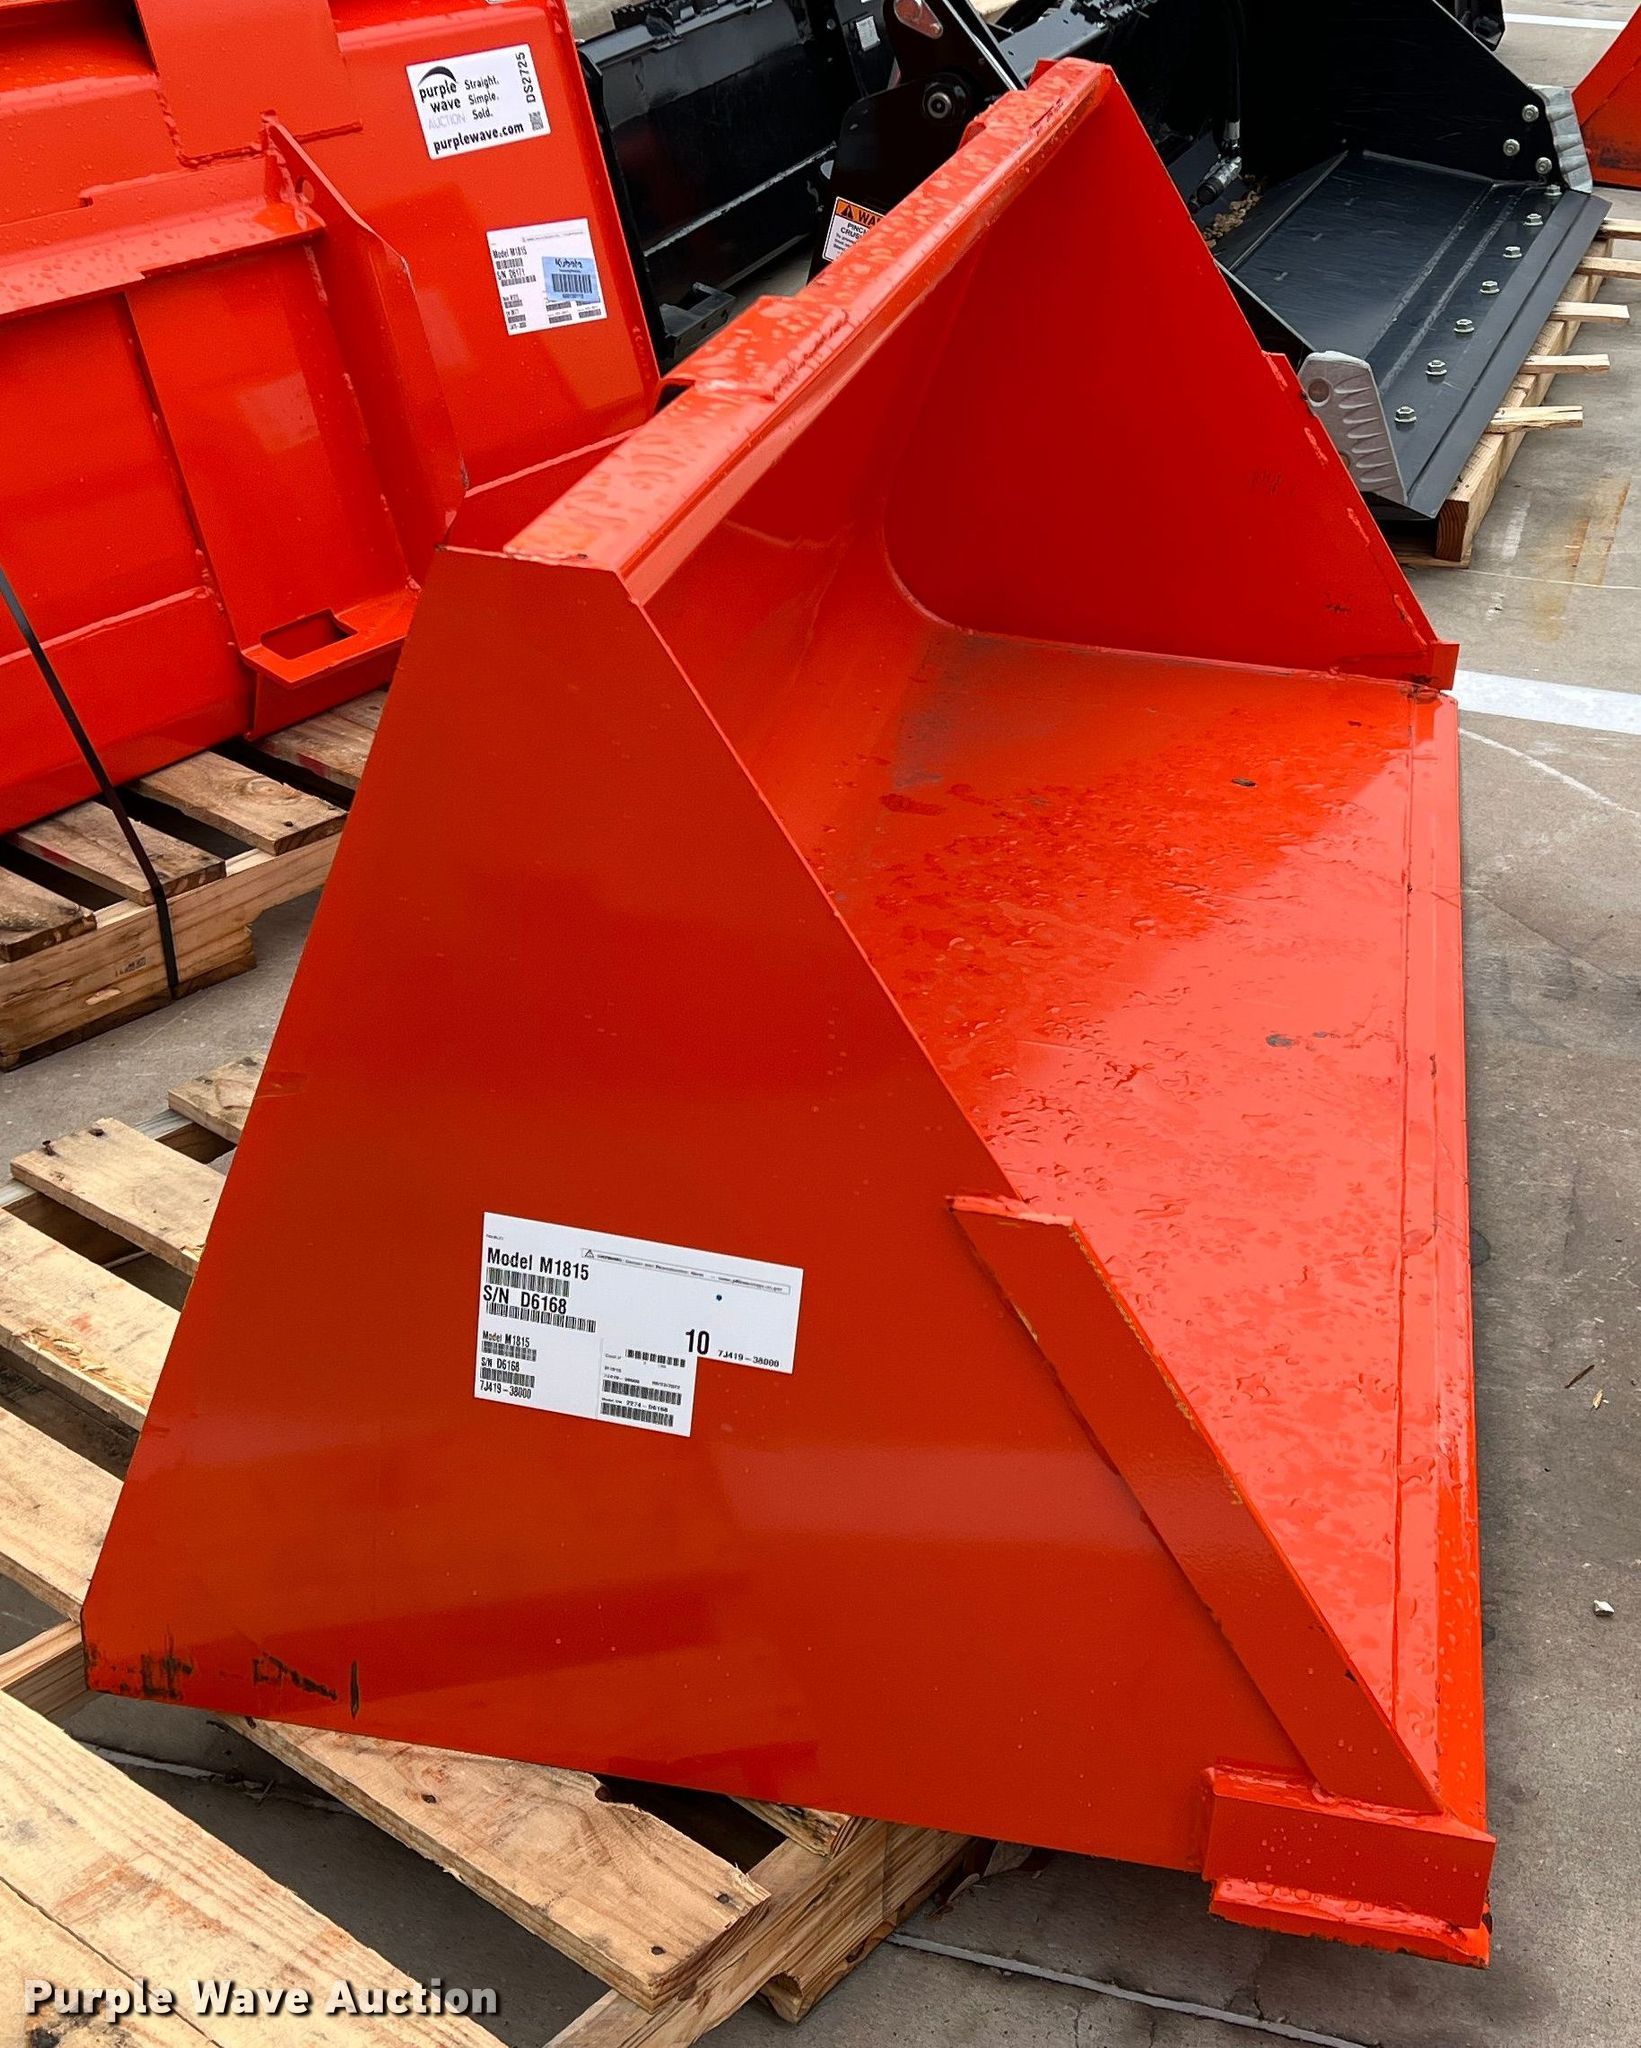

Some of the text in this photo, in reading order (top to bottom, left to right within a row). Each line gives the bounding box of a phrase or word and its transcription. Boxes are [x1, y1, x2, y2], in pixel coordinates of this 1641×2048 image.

[464, 75, 500, 91] Straight.
[515, 52, 536, 103] DS2725
[419, 79, 457, 102] purple
[468, 90, 500, 106] Simple.
[430, 98, 461, 113] wave
[472, 106, 494, 121] Sold.
[433, 122, 525, 155] purplewave.com
[840, 226, 862, 240] CRUS
[487, 1247, 533, 1271] Model
[539, 1256, 590, 1281] M1815
[482, 1284, 568, 1315] S/N D6168
[482, 1330, 531, 1348] Model M1815
[685, 1328, 711, 1355] 10
[481, 1356, 493, 1368] S/N
